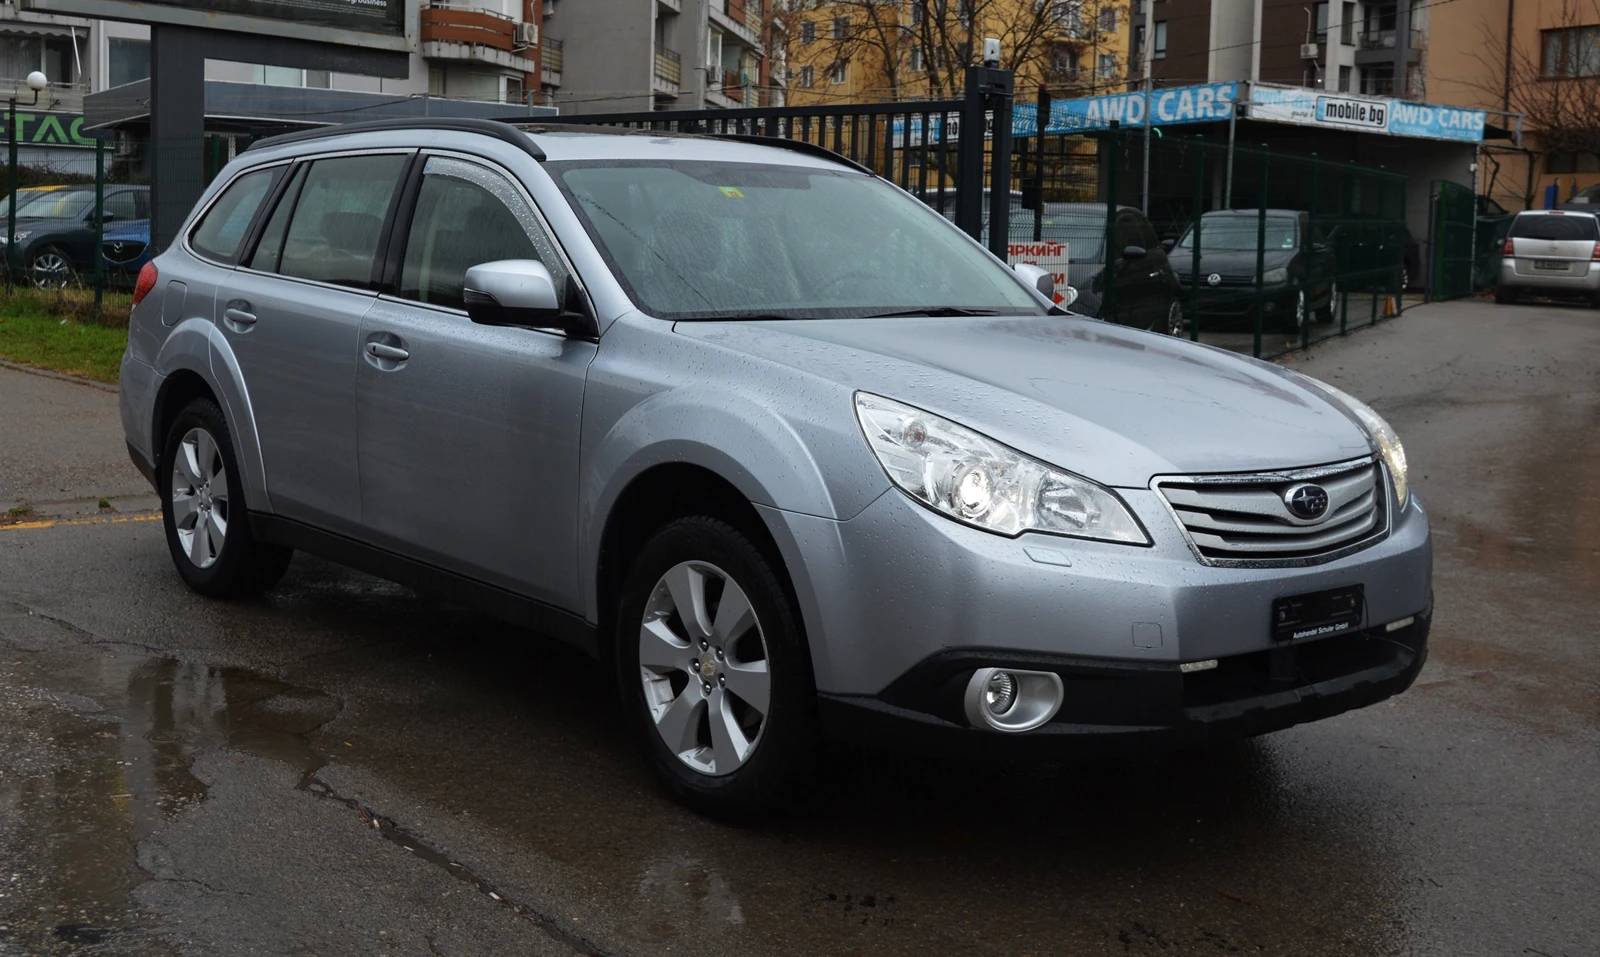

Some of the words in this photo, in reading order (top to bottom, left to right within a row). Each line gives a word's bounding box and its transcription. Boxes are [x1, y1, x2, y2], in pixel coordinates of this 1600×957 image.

[1085, 94, 1144, 128] AWD
[1158, 85, 1233, 122] CARS
[1325, 101, 1384, 125] mobile.bg
[1391, 103, 1434, 126] AWD
[1438, 108, 1485, 130] CARS
[1007, 244, 1067, 257] АРКИНГ
[1335, 622, 1348, 631] GmbH
